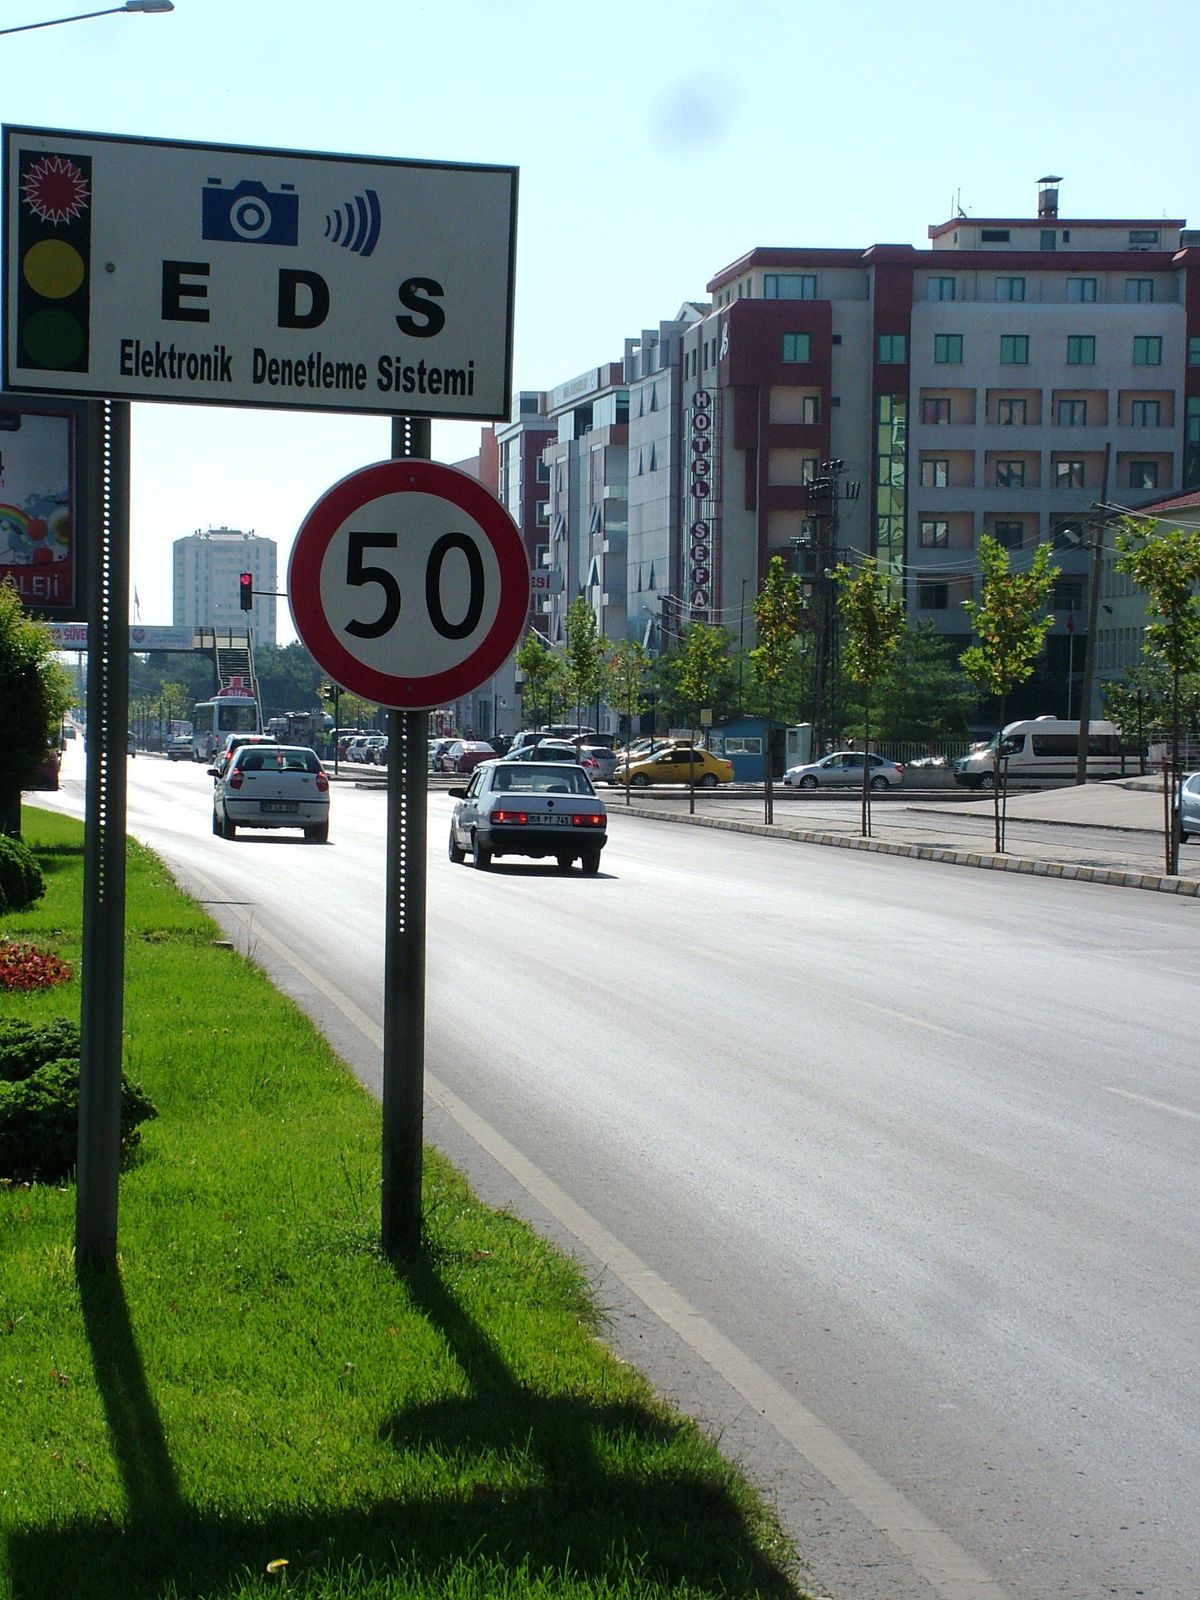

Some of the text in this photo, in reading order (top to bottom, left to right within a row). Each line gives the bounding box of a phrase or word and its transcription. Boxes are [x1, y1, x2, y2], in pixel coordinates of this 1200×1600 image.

[120, 339, 474, 396] Elektronik Denetleme Sistemi
[694, 392, 709, 497] HOTEL
[343, 531, 485, 641] 50
[693, 523, 707, 606] SEFA
